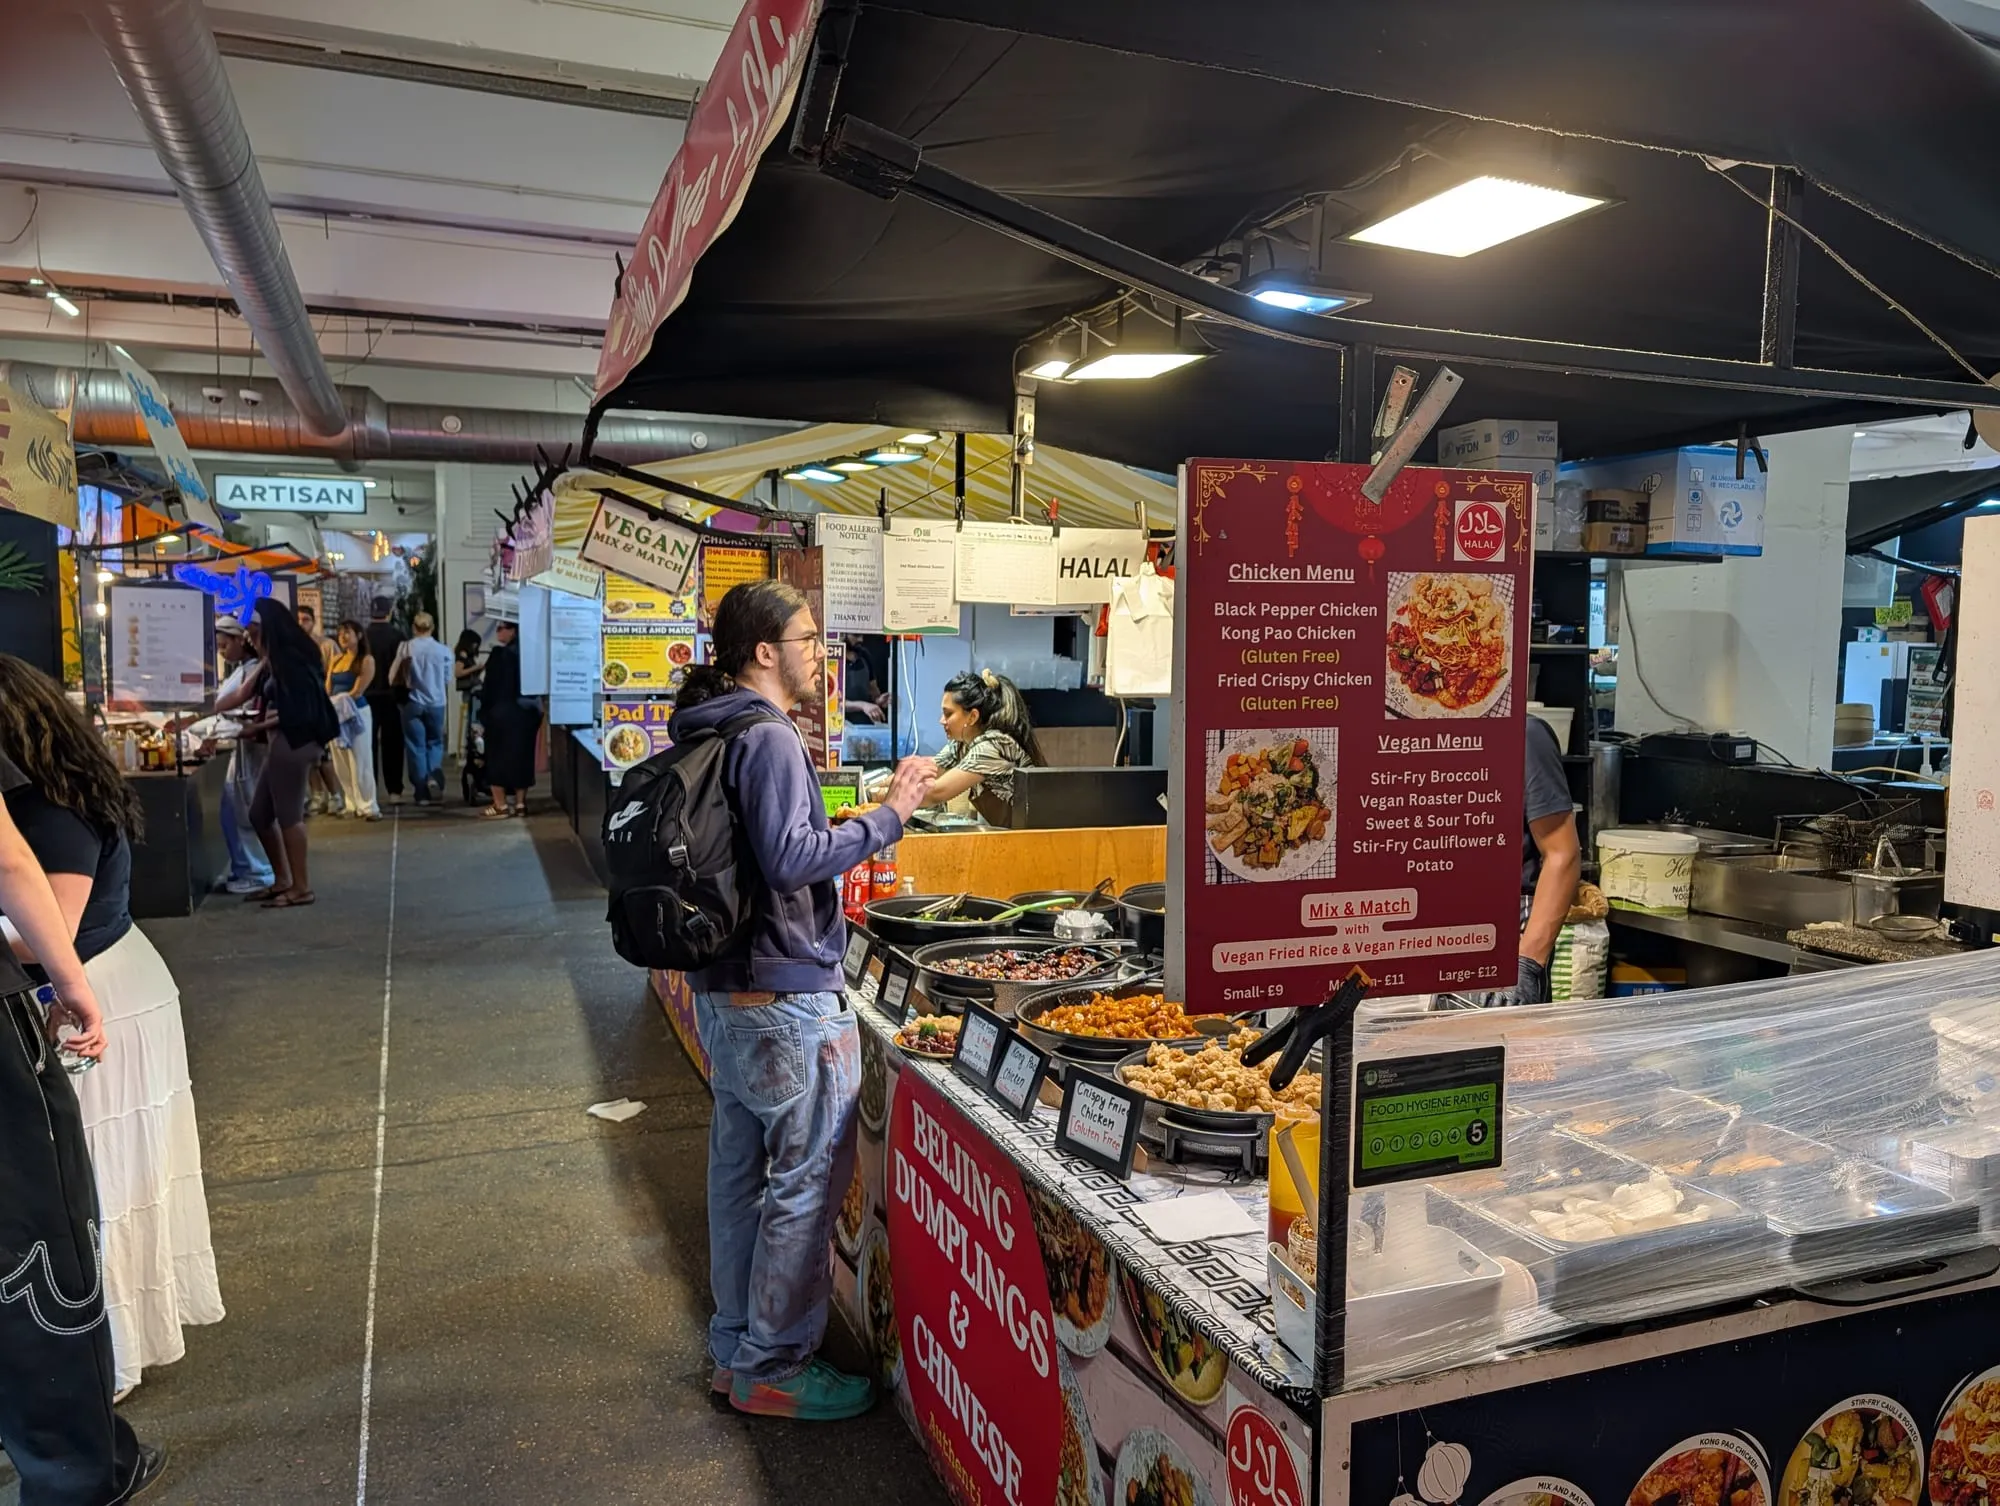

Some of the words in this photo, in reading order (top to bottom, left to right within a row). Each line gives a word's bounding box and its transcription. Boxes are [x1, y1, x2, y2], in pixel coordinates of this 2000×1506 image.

[228, 484, 353, 505] ARTISAN
[825, 522, 847, 531] FOOD
[848, 524, 882, 534] ALLERGY
[1459, 510, 1502, 535] حلال
[604, 510, 691, 560] VEGAN
[839, 532, 868, 541] NOTICE
[1464, 539, 1496, 549] HALAL
[593, 531, 620, 550] MIX
[623, 543, 634, 553] &
[636, 549, 683, 574] MATCH
[564, 570, 597, 584] MATCH
[1060, 557, 1132, 579] HALAL
[1228, 563, 1300, 580] Chicken
[1306, 565, 1355, 581] Menu
[834, 613, 856, 622] THANK
[857, 614, 871, 622] YOU
[1214, 603, 1257, 617] Black
[1260, 603, 1316, 621] Pepper
[1319, 602, 1378, 617] Chicken
[602, 626, 630, 634] VEGAN
[632, 626, 648, 634] MIX
[649, 626, 667, 634] AND
[1221, 626, 1260, 644] Kong
[1264, 626, 1293, 640] Pao
[1297, 626, 1356, 641] Chicken
[1241, 649, 1298, 664] (Gluten
[1301, 648, 1341, 664] Free)
[1218, 673, 1258, 688] Fried
[1260, 673, 1310, 691] Crispy
[1313, 672, 1373, 687] Chicken
[604, 704, 645, 722] Pad
[1240, 696, 1298, 712] (Gluten
[1301, 695, 1340, 711] Free)
[1378, 734, 1431, 753] Vegan
[1436, 733, 1483, 750] Menu
[1371, 771, 1427, 789] Stir-Fry
[1430, 768, 1489, 784] Broccoli
[1360, 795, 1404, 812] Vegan
[1409, 791, 1463, 806] Roaster
[1467, 789, 1502, 803] Duck
[1366, 817, 1410, 831] Sweet
[1413, 815, 1424, 828] &
[1427, 814, 1459, 828] Sour
[1464, 811, 1495, 826] Tofu
[608, 831, 632, 842] AIR
[1353, 840, 1409, 857] Stir-Fry
[1412, 834, 1493, 851] Cauliflower
[1496, 833, 1506, 846] &
[1407, 858, 1454, 873] Potato
[1309, 902, 1339, 918] Mix
[1343, 901, 1355, 916] &
[1359, 897, 1411, 915] Match
[1345, 923, 1369, 935] with
[1220, 949, 1264, 966] Vegan
[1268, 946, 1305, 961] Fried
[1309, 943, 1338, 957] Rice
[1342, 942, 1351, 955] &
[1355, 939, 1395, 956] Vegan
[1399, 936, 1433, 950] Fried
[1436, 932, 1489, 947] Noodles
[1223, 986, 1265, 1000] Small-
[1268, 984, 1284, 997] £9
[1384, 974, 1405, 987] £11
[1438, 967, 1475, 983] Large-
[1477, 965, 1498, 979] £12
[1011, 1046, 1026, 1070] Kong
[1026, 1055, 1039, 1072] Pao
[1003, 1067, 1025, 1089] Chicken
[1370, 1103, 1404, 1117] FOOD
[1406, 1096, 1452, 1112] HYGIENE
[1453, 1090, 1490, 1105] RATING
[1081, 1103, 1115, 1131] Chicken
[1471, 1122, 1483, 1142] 5
[911, 1099, 1015, 1251] BEIJING
[894, 1148, 1050, 1378] DUMPLINGS
[949, 1290, 969, 1350] &
[913, 1315, 1023, 1506] CHINESE
[1851, 1399, 1881, 1407] STIR-FRY
[1880, 1401, 1898, 1415] CAULI
[1897, 1411, 1903, 1419] &
[1900, 1415, 1919, 1443] POTATO
[1699, 1437, 1720, 1447] KONG
[1720, 1439, 1735, 1449] PAO
[1734, 1445, 1760, 1471] CHICKEN
[1537, 1481, 1551, 1491] MIX
[1553, 1484, 1570, 1497] AND
[1568, 1491, 1590, 1506] MATC
